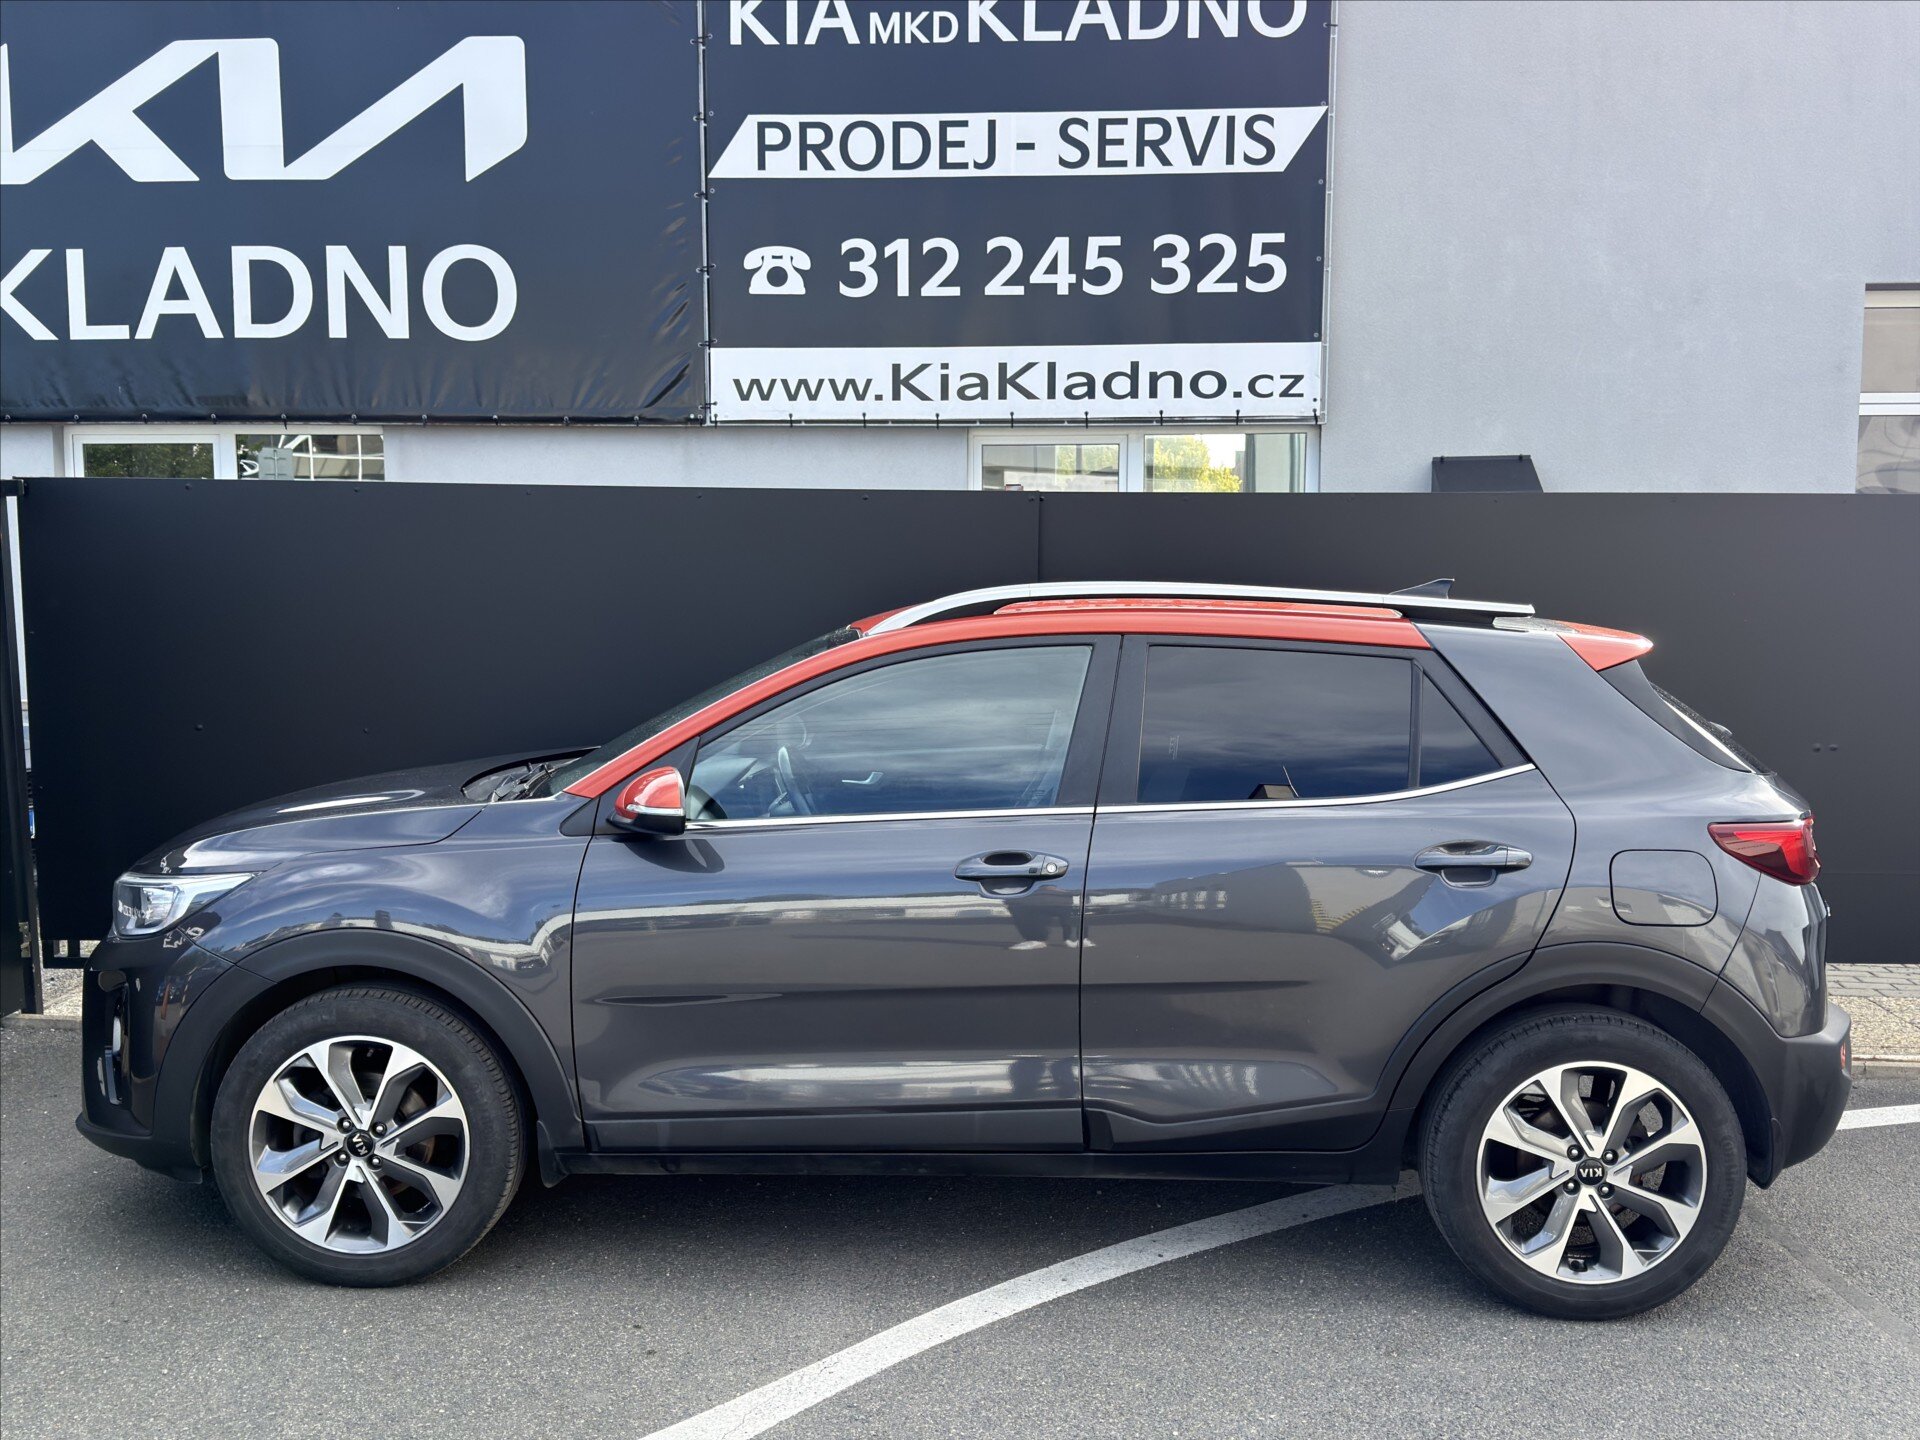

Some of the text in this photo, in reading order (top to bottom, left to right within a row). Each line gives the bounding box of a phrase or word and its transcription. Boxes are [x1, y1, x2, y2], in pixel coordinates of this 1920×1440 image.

[729, 0, 1307, 46] KIA MKD KLADNO
[757, 119, 997, 172] PRODEJ
[1058, 114, 1276, 169] SERVIS
[839, 233, 1287, 298] 312 245 325
[733, 360, 1305, 402] www.KiaKladno.cz
[352, 1133, 369, 1156] KIA
[1579, 1167, 1603, 1178] KIA
